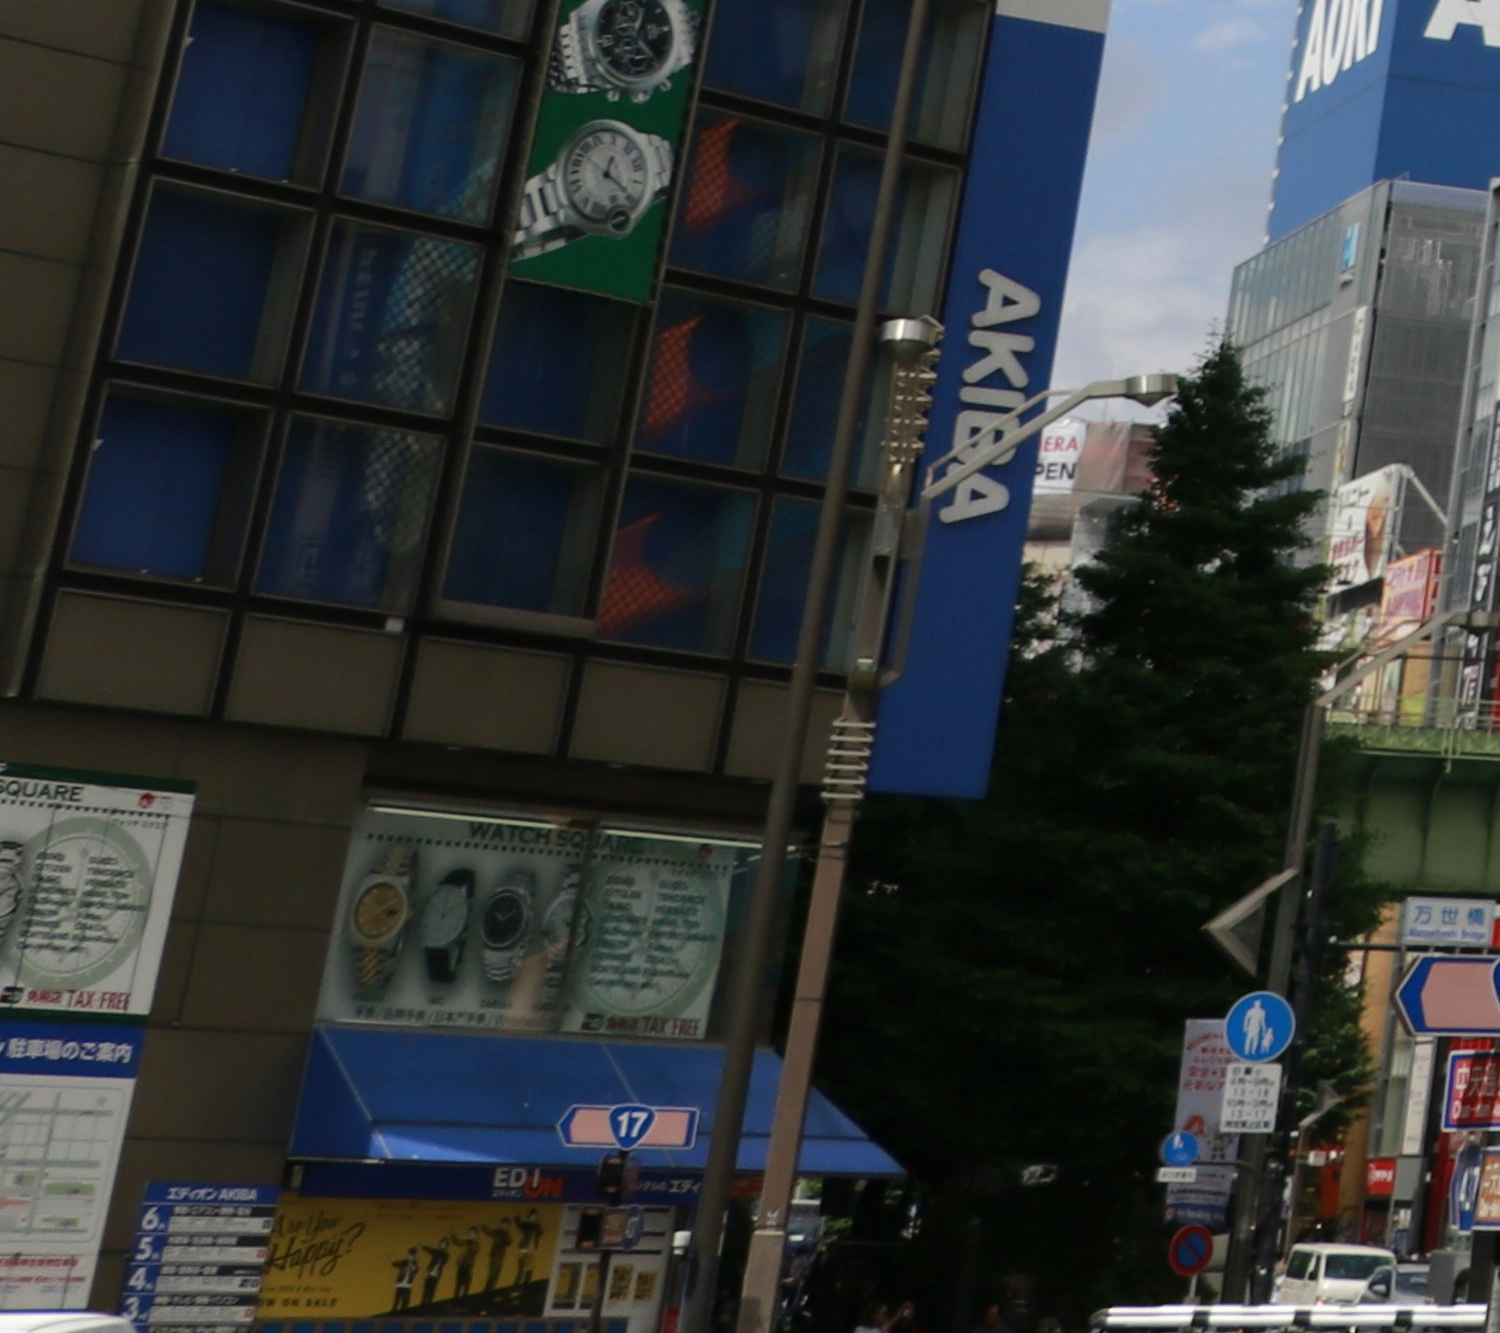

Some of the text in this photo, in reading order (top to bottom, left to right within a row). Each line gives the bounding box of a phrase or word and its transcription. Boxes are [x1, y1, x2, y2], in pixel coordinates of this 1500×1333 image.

[939, 268, 1042, 525] AKIBA
[1413, 905, 1488, 926] 万世橋
[617, 1111, 648, 1138] 17
[493, 1167, 564, 1199] EDION
